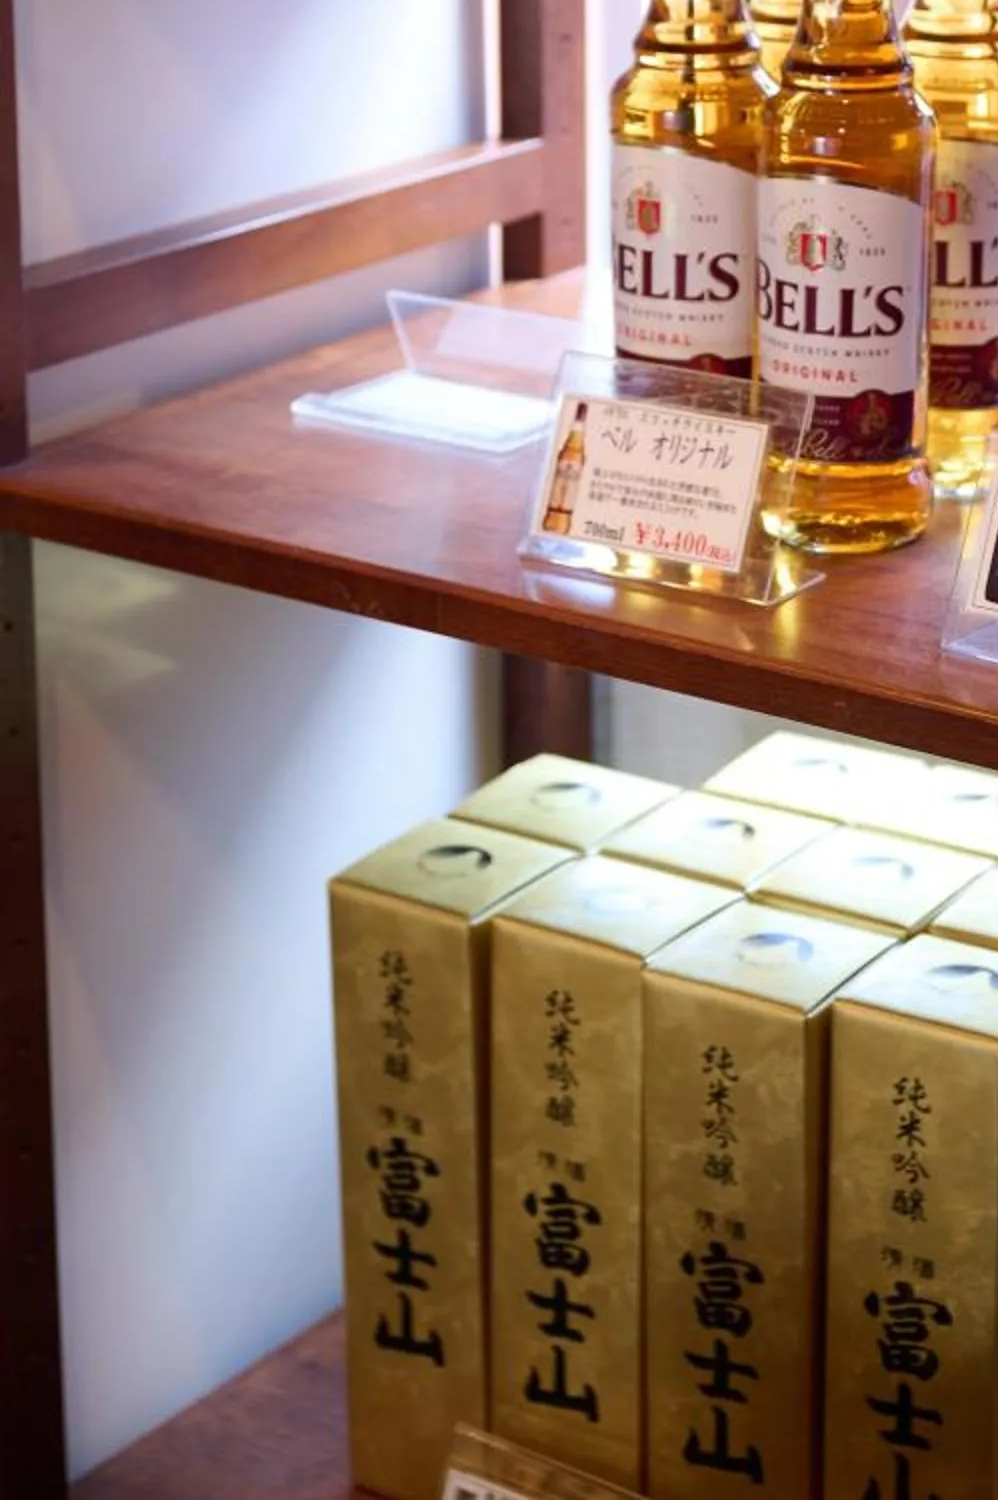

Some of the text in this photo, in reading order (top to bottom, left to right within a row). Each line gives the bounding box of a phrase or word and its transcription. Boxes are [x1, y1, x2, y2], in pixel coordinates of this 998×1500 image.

[612, 242, 741, 303] ELL'S
[757, 258, 907, 339] BELL'S
[772, 359, 859, 384] ORIGINAL
[601, 426, 734, 471] ベル オリジナル
[544, 990, 580, 1128] 純米吟醸
[702, 1045, 739, 1187] 純米吟醸
[891, 1077, 932, 1224] 純米吟醸
[366, 1136, 446, 1368] 富士山
[523, 1182, 602, 1423] 富士山
[679, 1241, 764, 1485] 富士山
